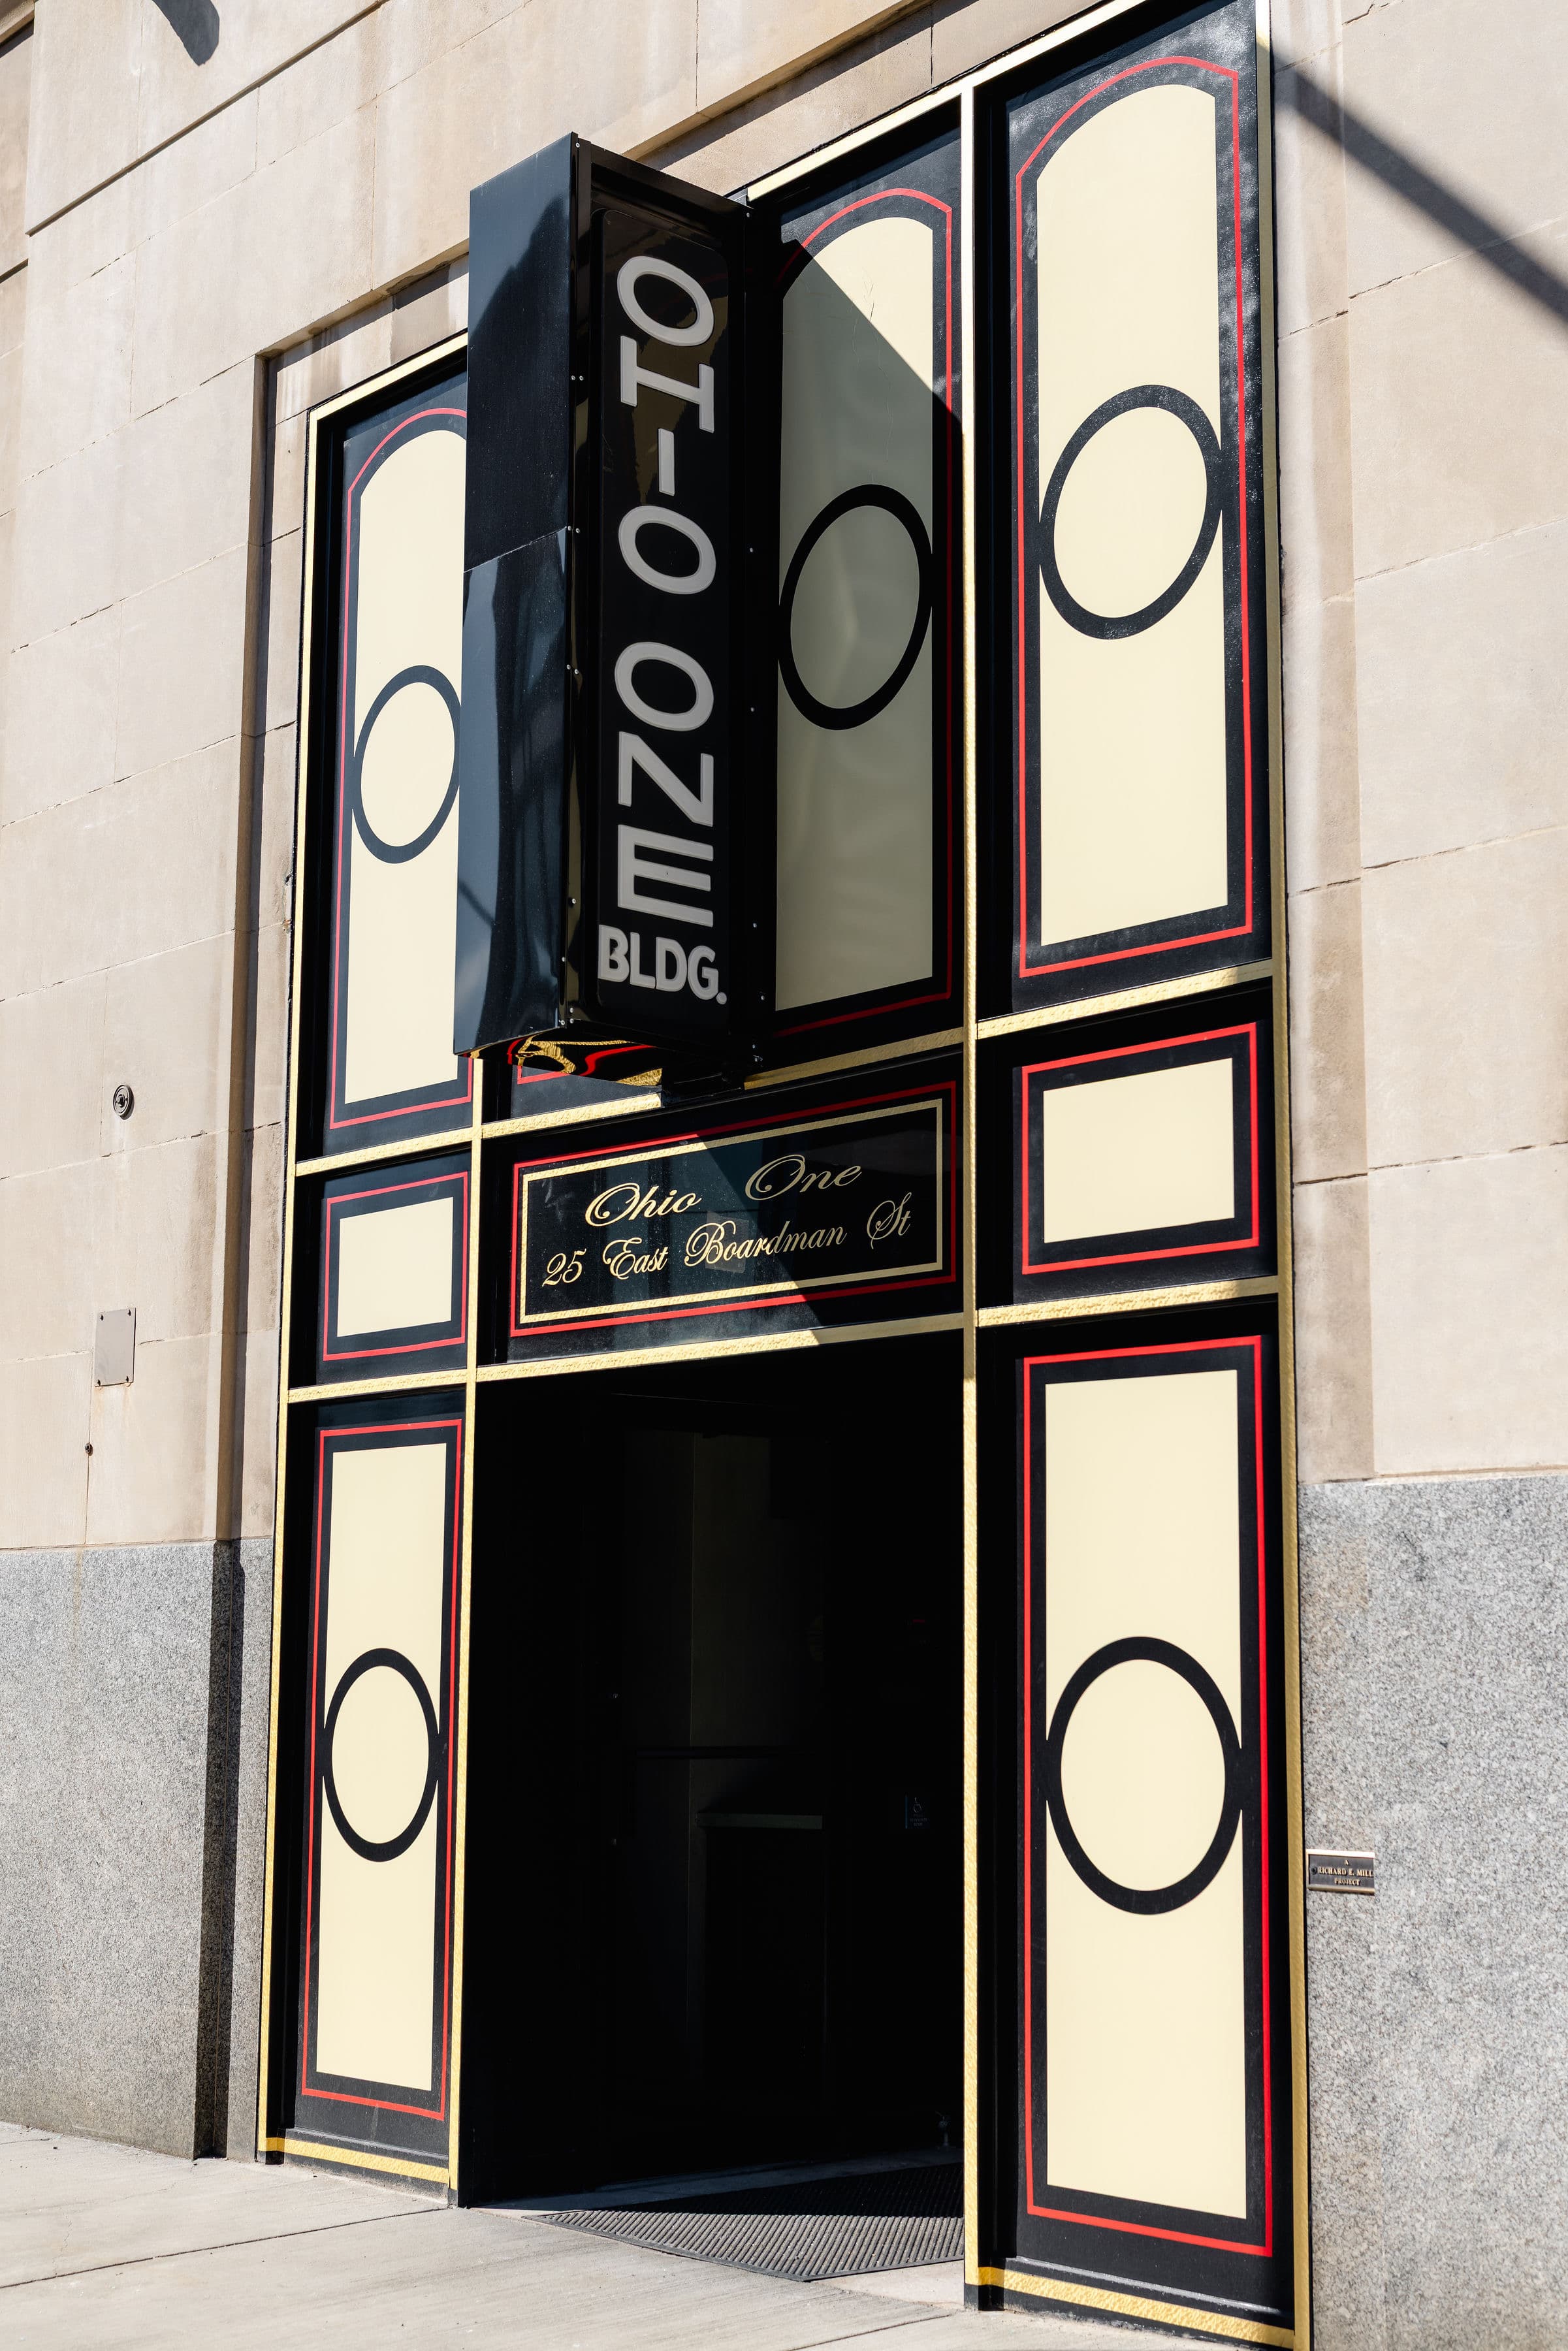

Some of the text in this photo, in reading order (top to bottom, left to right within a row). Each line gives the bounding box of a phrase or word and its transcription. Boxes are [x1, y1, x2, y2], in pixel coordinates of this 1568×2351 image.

[615, 255, 716, 927] OHIO ONE
[598, 924, 727, 1004] BLDG.
[585, 1154, 862, 1227] Ohio One
[541, 1192, 911, 1287] 25 East Boardman St
[1317, 1866, 1347, 1876] RICHARD
[1356, 1869, 1374, 1878] MILL
[1334, 1878, 1360, 1886] PROJECT
